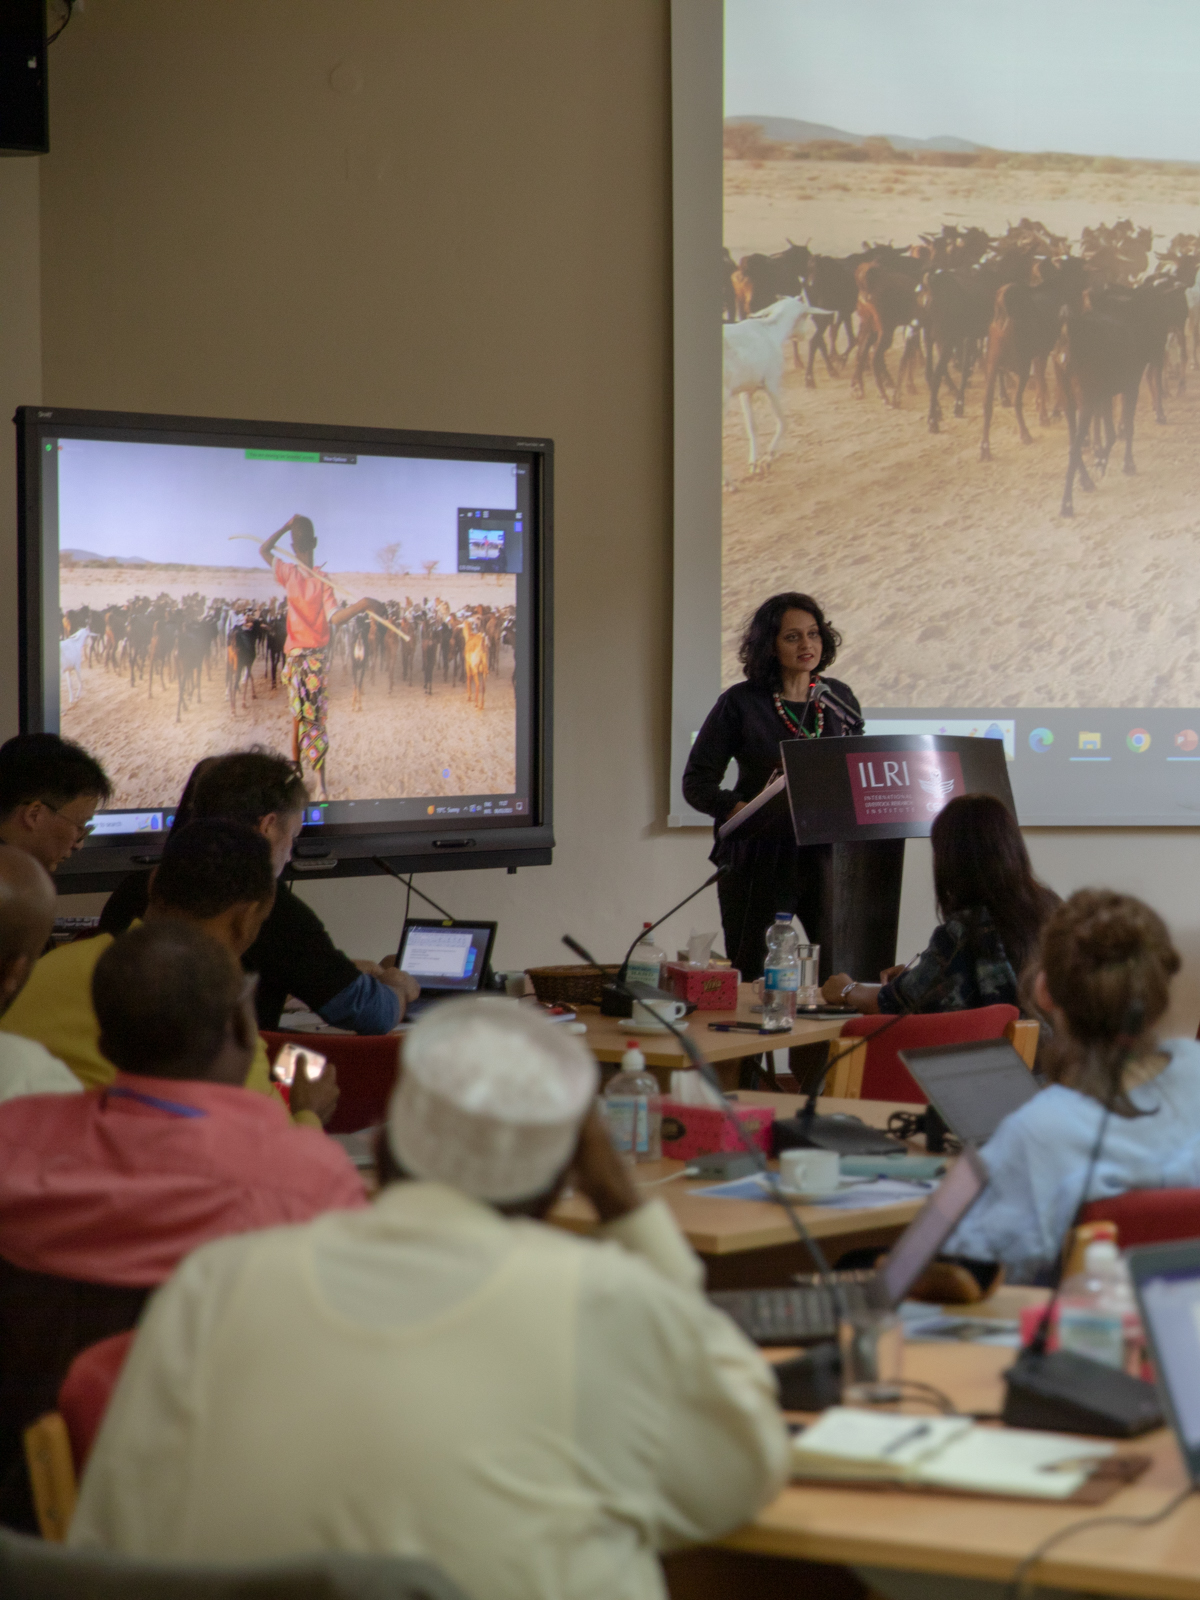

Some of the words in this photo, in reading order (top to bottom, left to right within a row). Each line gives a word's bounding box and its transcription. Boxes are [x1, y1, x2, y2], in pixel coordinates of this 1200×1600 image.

[858, 761, 910, 788] ILRI
[864, 793, 913, 802] INTERNATIONAL
[866, 807, 915, 815] INSTITUTE
